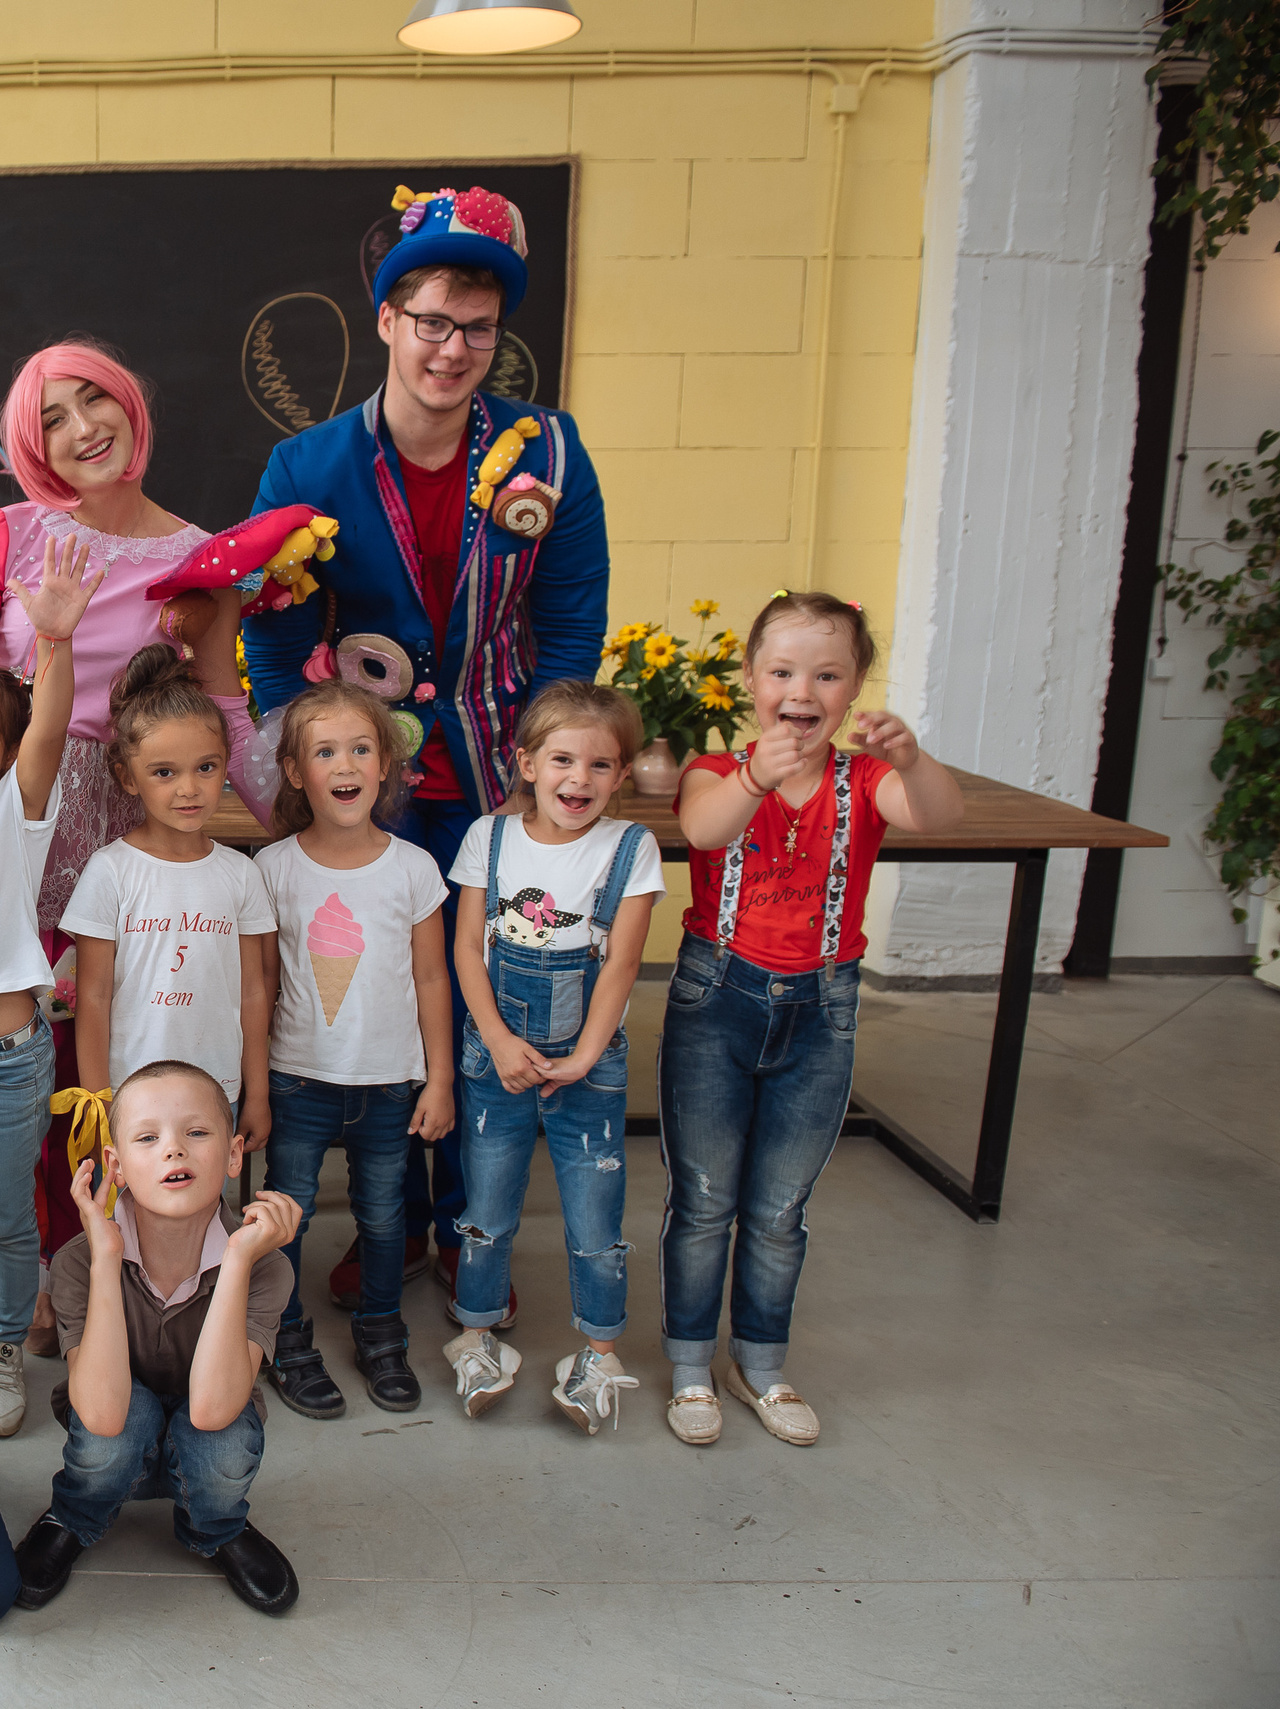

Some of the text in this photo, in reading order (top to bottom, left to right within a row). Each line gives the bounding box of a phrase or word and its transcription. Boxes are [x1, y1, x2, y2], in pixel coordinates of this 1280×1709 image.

[124, 911, 233, 936] Lara Maria
[170, 945, 189, 973] 5
[150, 990, 194, 1007] лет
